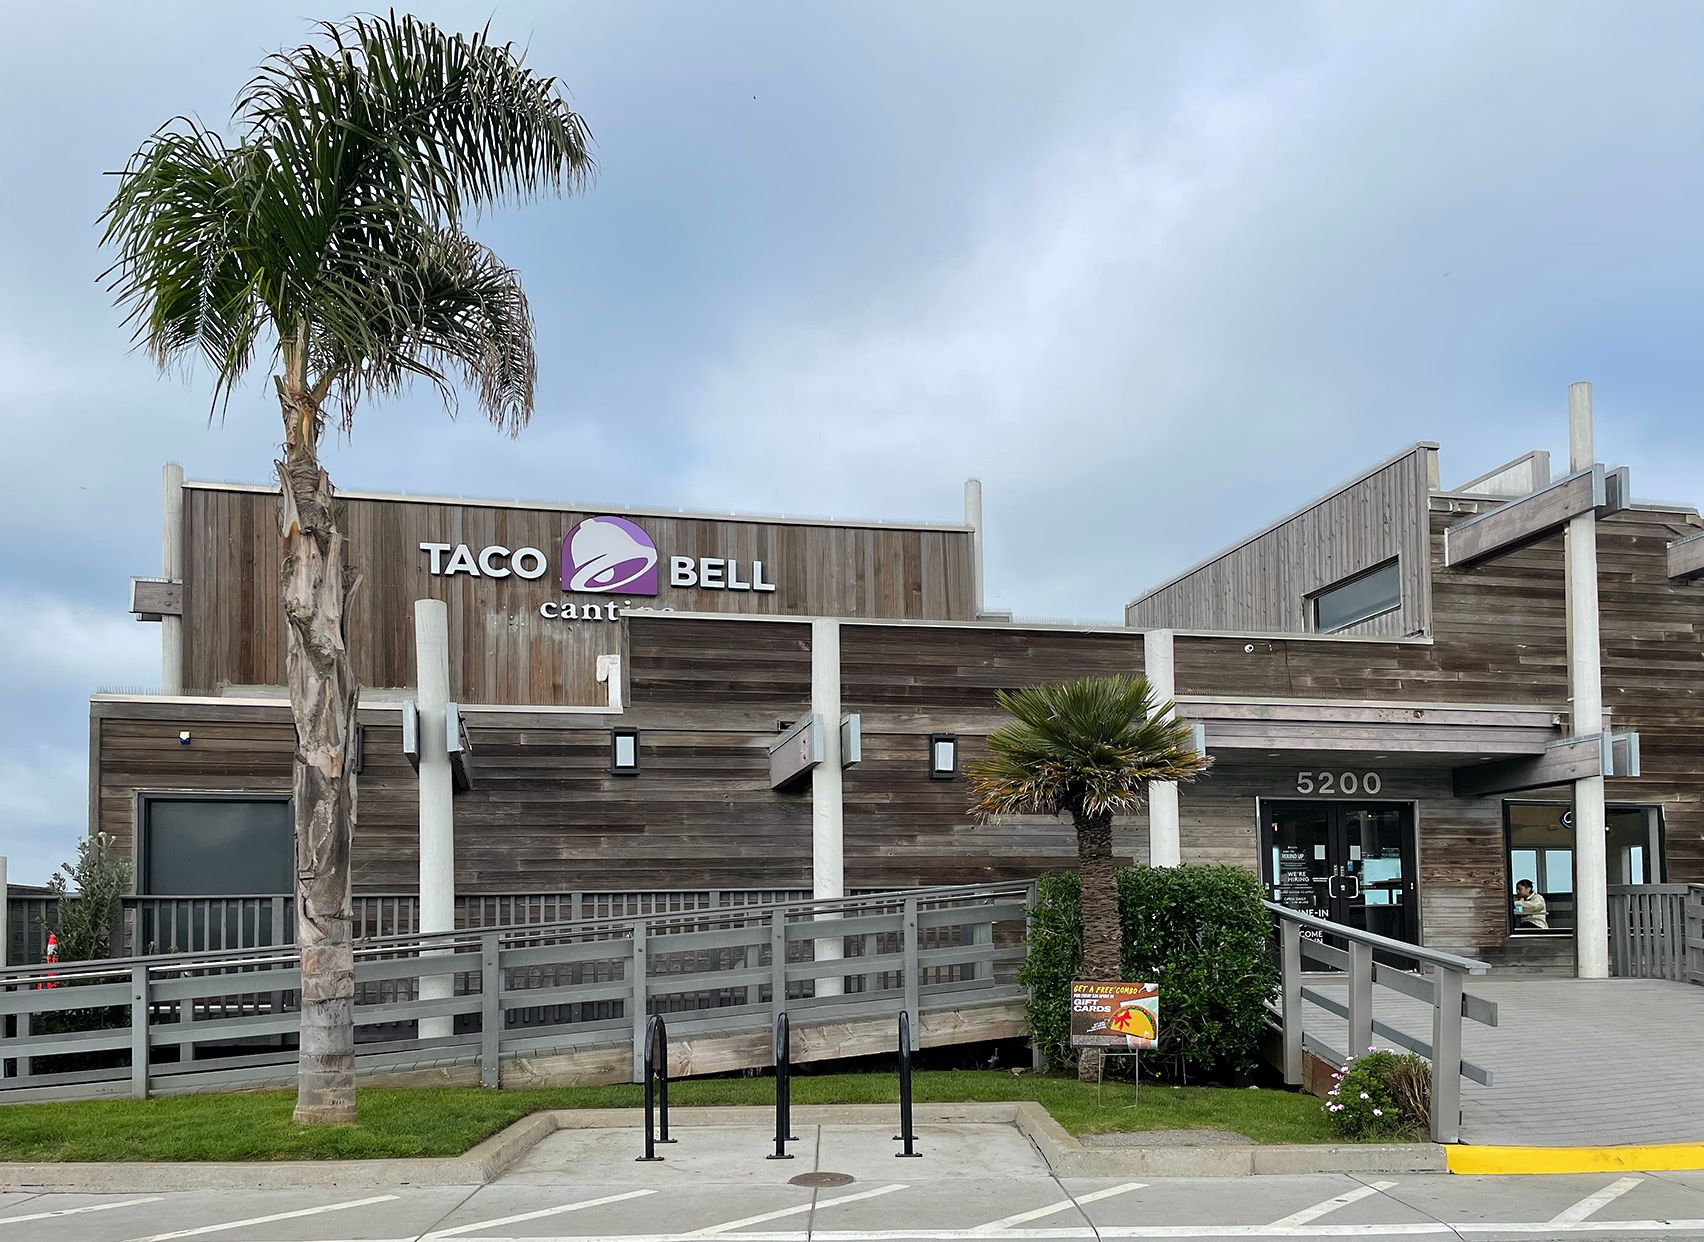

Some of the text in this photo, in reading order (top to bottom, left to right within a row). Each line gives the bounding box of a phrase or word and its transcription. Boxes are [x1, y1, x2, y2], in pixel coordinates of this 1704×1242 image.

[419, 542, 776, 592] TACO BELL
[1297, 771, 1381, 795] 5200
[1073, 984, 1138, 995] GET A FREE COMBO
[1073, 998, 1099, 1006] GIFT
[1073, 1005, 1112, 1013] CARDS
